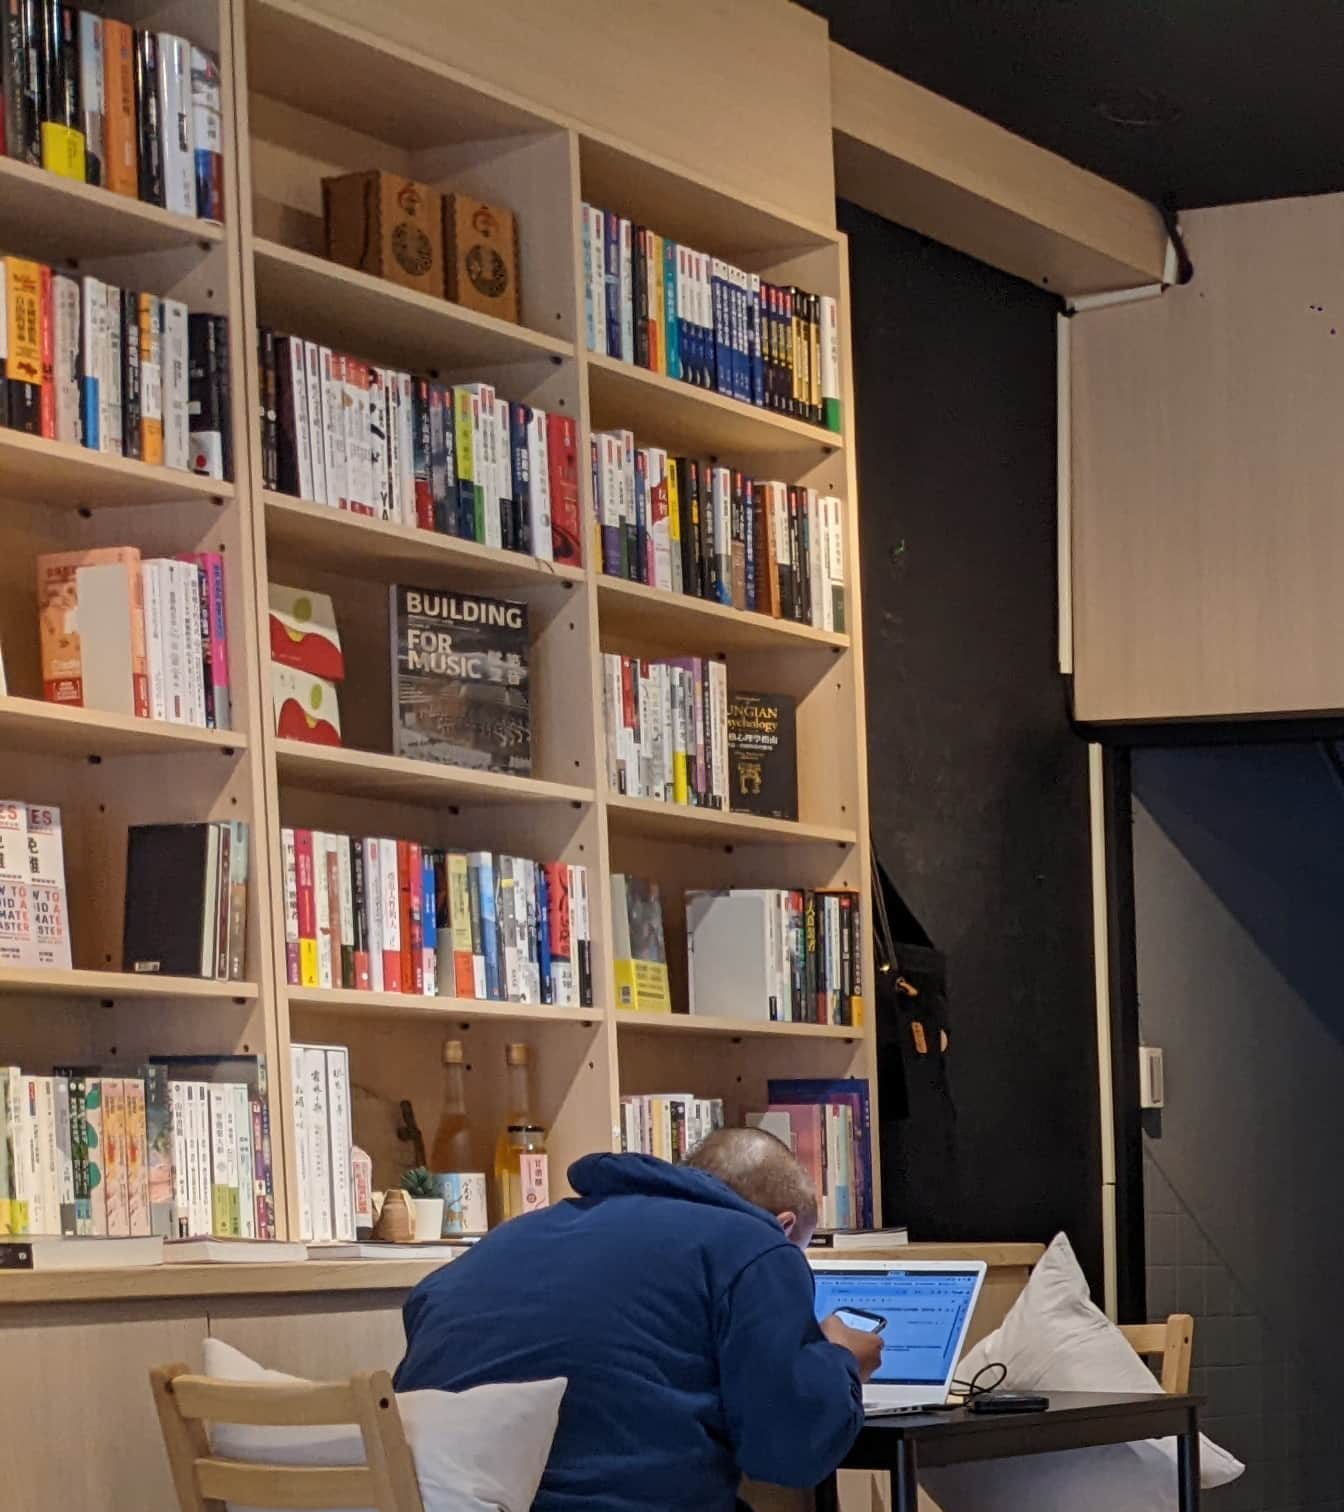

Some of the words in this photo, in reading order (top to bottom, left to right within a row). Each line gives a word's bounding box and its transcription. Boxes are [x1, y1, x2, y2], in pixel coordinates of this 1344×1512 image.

[406, 591, 522, 629] BUILDING
[407, 629, 453, 654] FOR
[408, 650, 482, 679] MUSIC
[728, 706, 777, 718] UNGIAN
[12, 885, 27, 898] TO
[0, 910, 29, 922] MATE
[0, 921, 30, 932] ASTER
